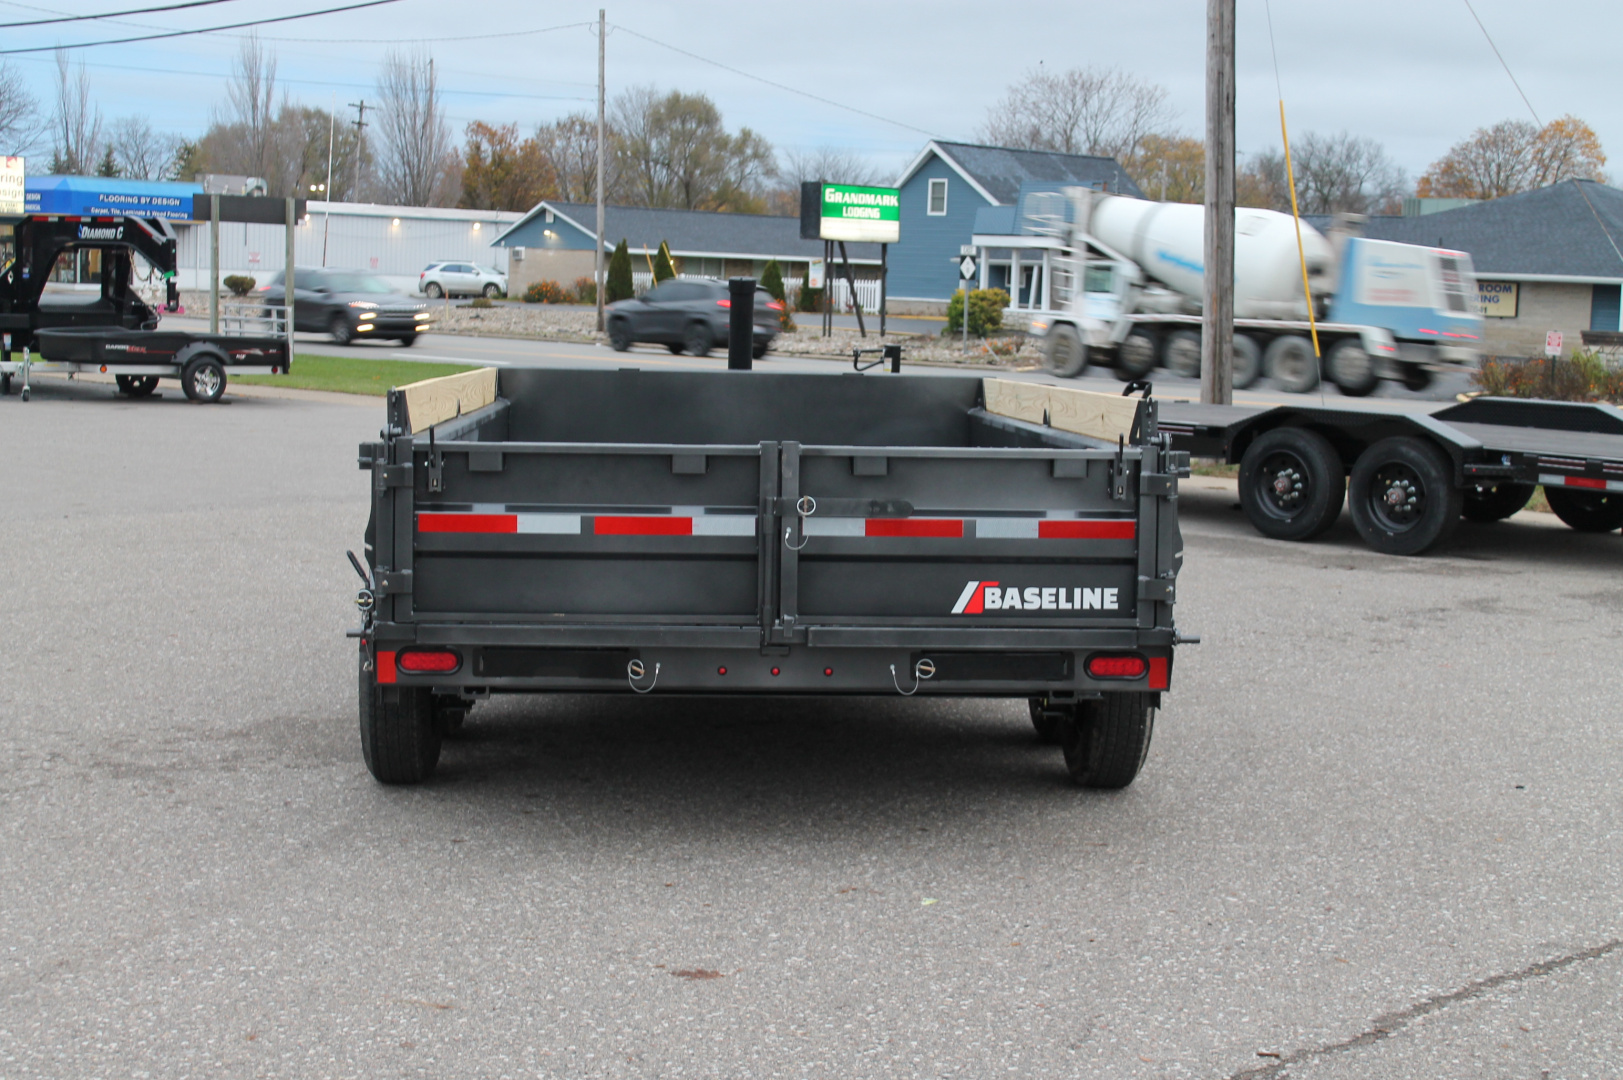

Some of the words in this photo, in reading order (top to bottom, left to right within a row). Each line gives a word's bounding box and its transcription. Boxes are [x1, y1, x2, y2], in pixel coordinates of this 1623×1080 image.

[0, 187, 24, 199] sign
[825, 188, 898, 206] GRANDMARK
[99, 194, 138, 204] FLOORING
[152, 198, 180, 206] DESIGN
[167, 210, 188, 220] Flooring
[843, 206, 880, 218] LODGING
[81, 225, 116, 239] DIAMOND
[116, 225, 124, 240] C
[1478, 284, 1512, 293] ROOM
[984, 586, 1119, 610] BASELINE
